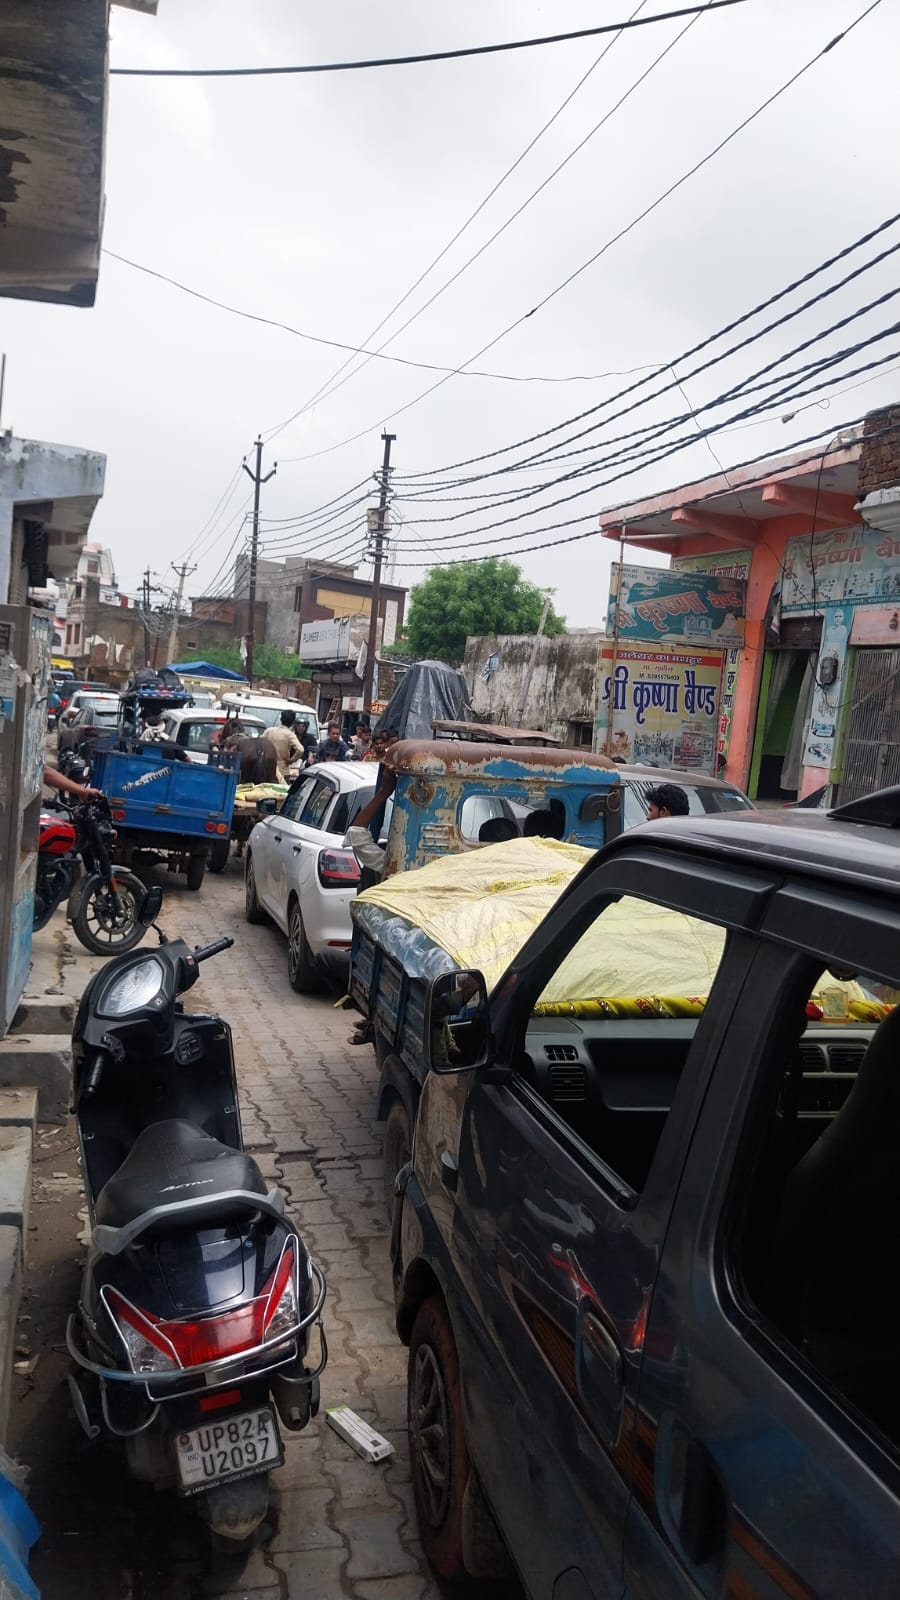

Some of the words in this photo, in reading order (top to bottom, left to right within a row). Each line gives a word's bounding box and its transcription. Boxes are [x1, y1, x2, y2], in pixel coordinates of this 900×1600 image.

[628, 590, 709, 632] कृष्णा
[655, 652, 669, 662] का
[602, 665, 630, 710] श्री
[632, 680, 680, 725] कृष्णा
[683, 669, 716, 716] बैण्ड
[197, 1414, 269, 1452] UP82A
[202, 1436, 270, 1477] U2097
